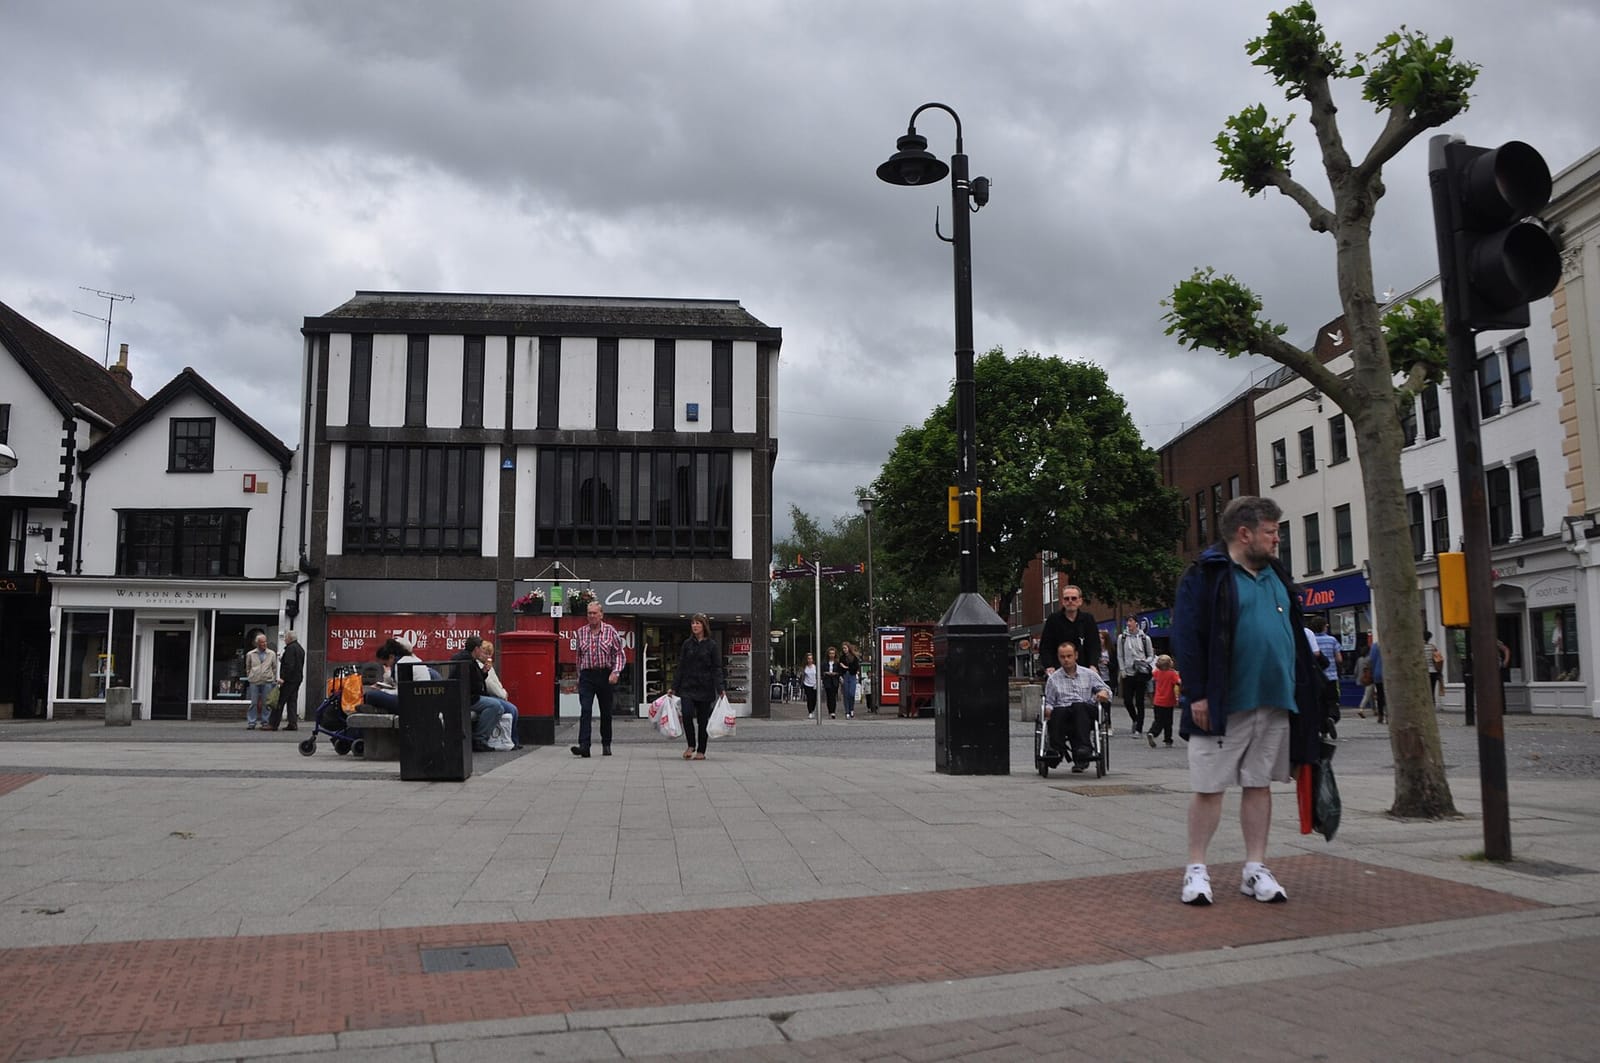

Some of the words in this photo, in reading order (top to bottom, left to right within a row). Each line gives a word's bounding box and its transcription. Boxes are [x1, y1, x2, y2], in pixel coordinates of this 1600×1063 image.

[116, 588, 169, 598] WATSON
[174, 590, 182, 598] &
[187, 590, 227, 599] SMITH
[604, 588, 663, 606] Clarks
[1305, 587, 1335, 607] Zone
[330, 629, 377, 639] SUMMER
[434, 629, 481, 639] SUMMER
[414, 686, 445, 695] LITTER
